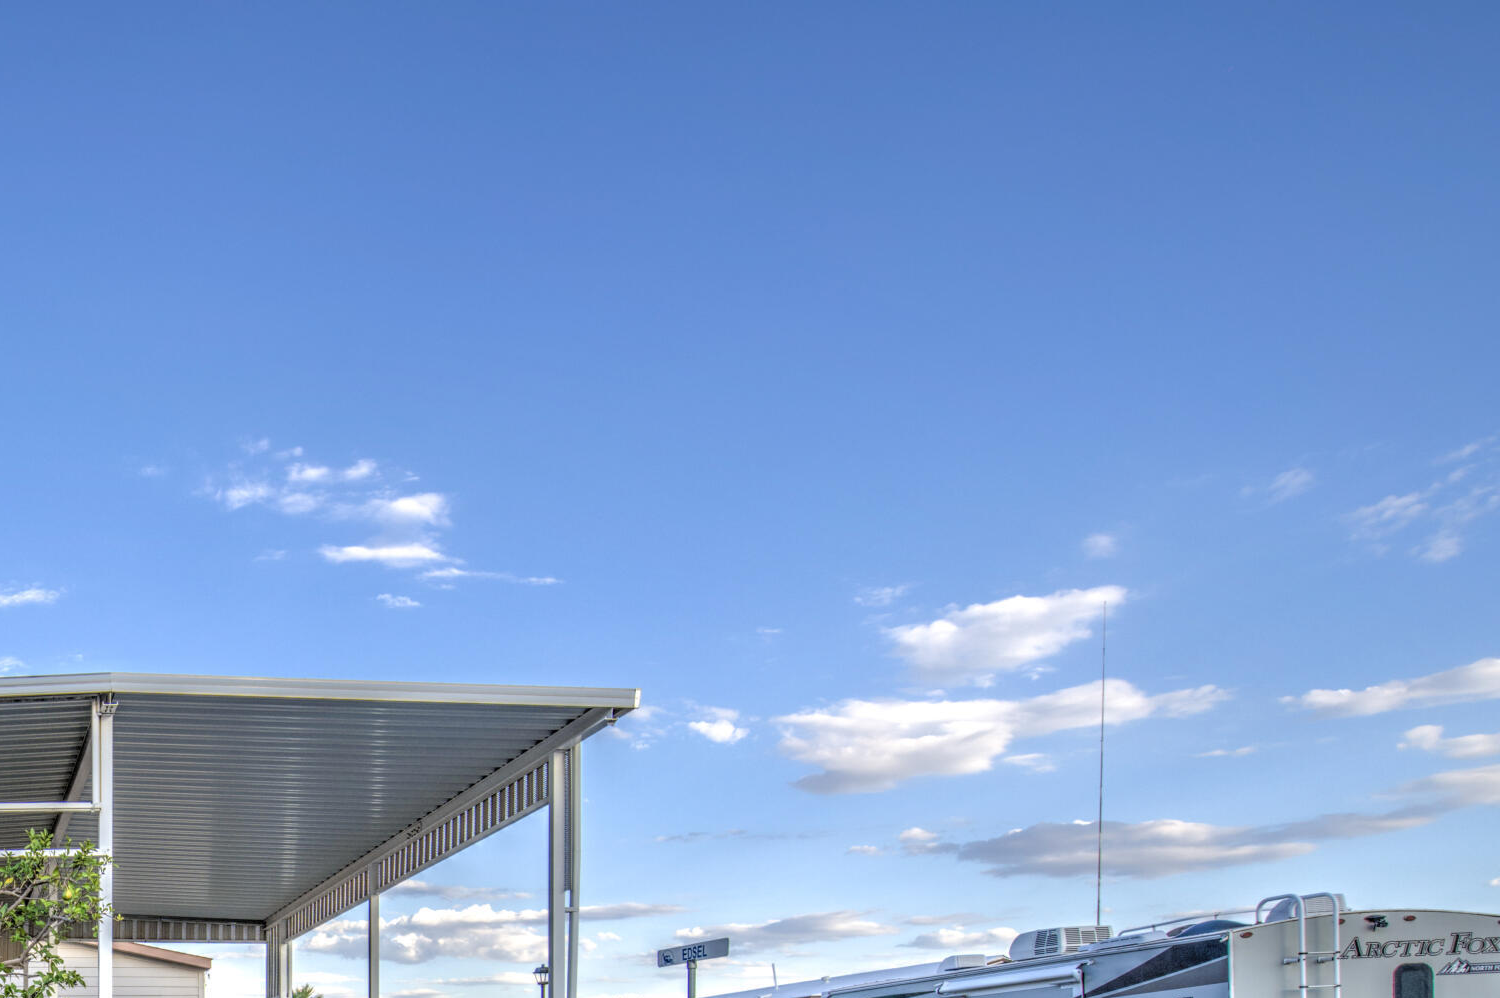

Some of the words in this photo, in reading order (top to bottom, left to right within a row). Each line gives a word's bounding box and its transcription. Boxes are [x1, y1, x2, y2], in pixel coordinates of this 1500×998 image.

[682, 945, 707, 960] EDSEL
[1337, 936, 1445, 959] ARCTIC
[1446, 931, 1500, 955] FOX
